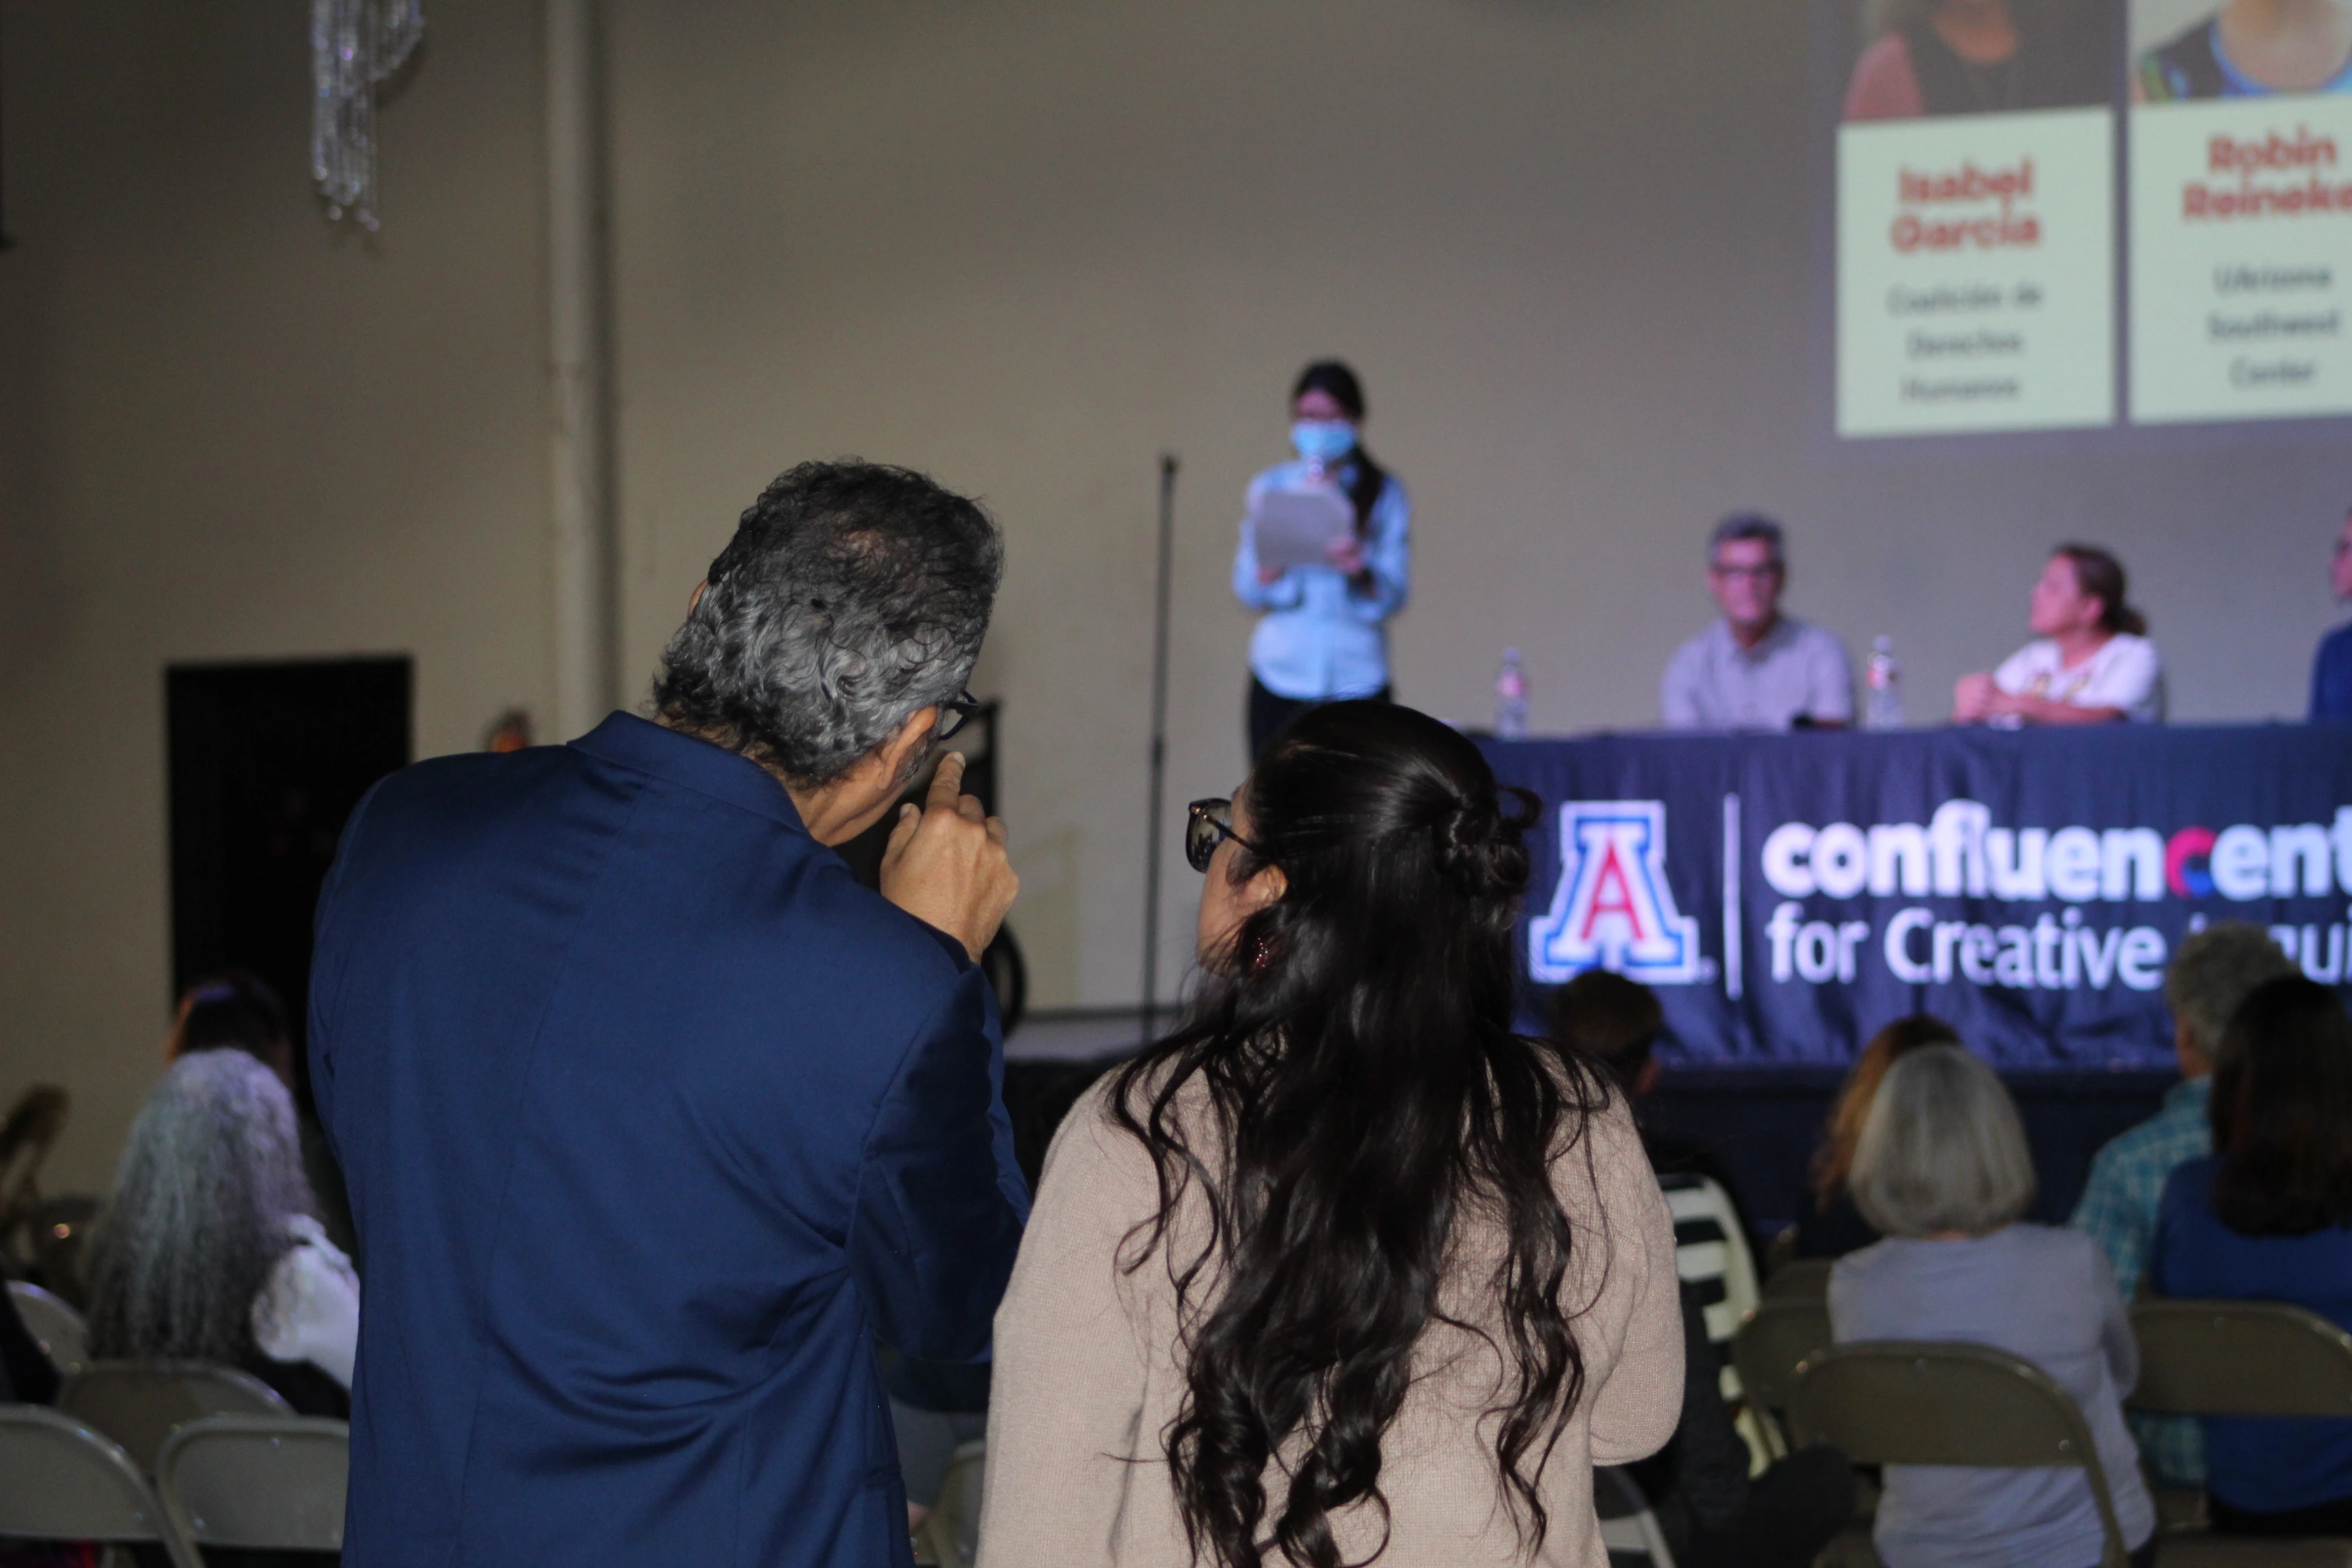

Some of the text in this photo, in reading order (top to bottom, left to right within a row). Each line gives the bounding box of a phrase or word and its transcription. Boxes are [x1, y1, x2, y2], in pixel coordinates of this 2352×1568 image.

[2207, 126, 2338, 170] Robin
[1897, 161, 2034, 202] Isabel
[1764, 901, 1869, 984] for
[1883, 906, 2167, 991] Creative
